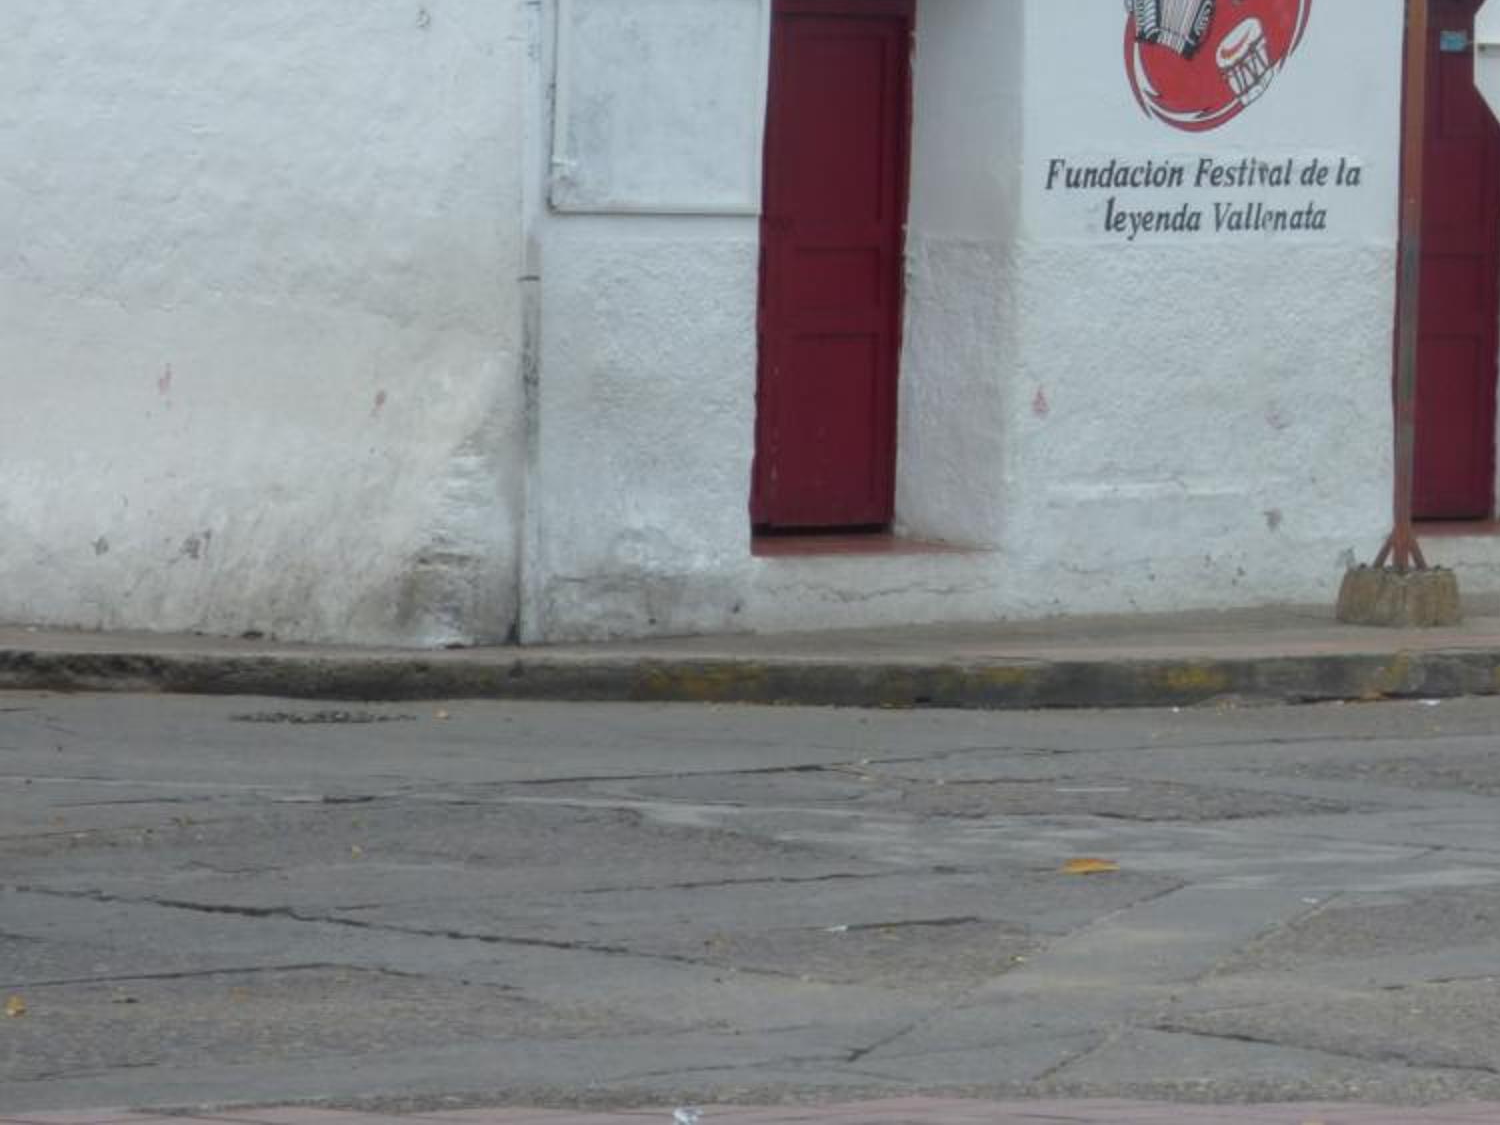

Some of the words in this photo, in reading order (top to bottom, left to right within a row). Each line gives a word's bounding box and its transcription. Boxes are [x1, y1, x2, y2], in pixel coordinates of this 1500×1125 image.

[1194, 158, 1293, 187] Festival
[1300, 158, 1329, 187] de
[1335, 158, 1361, 187] la
[1214, 201, 1326, 232] Vallenata
